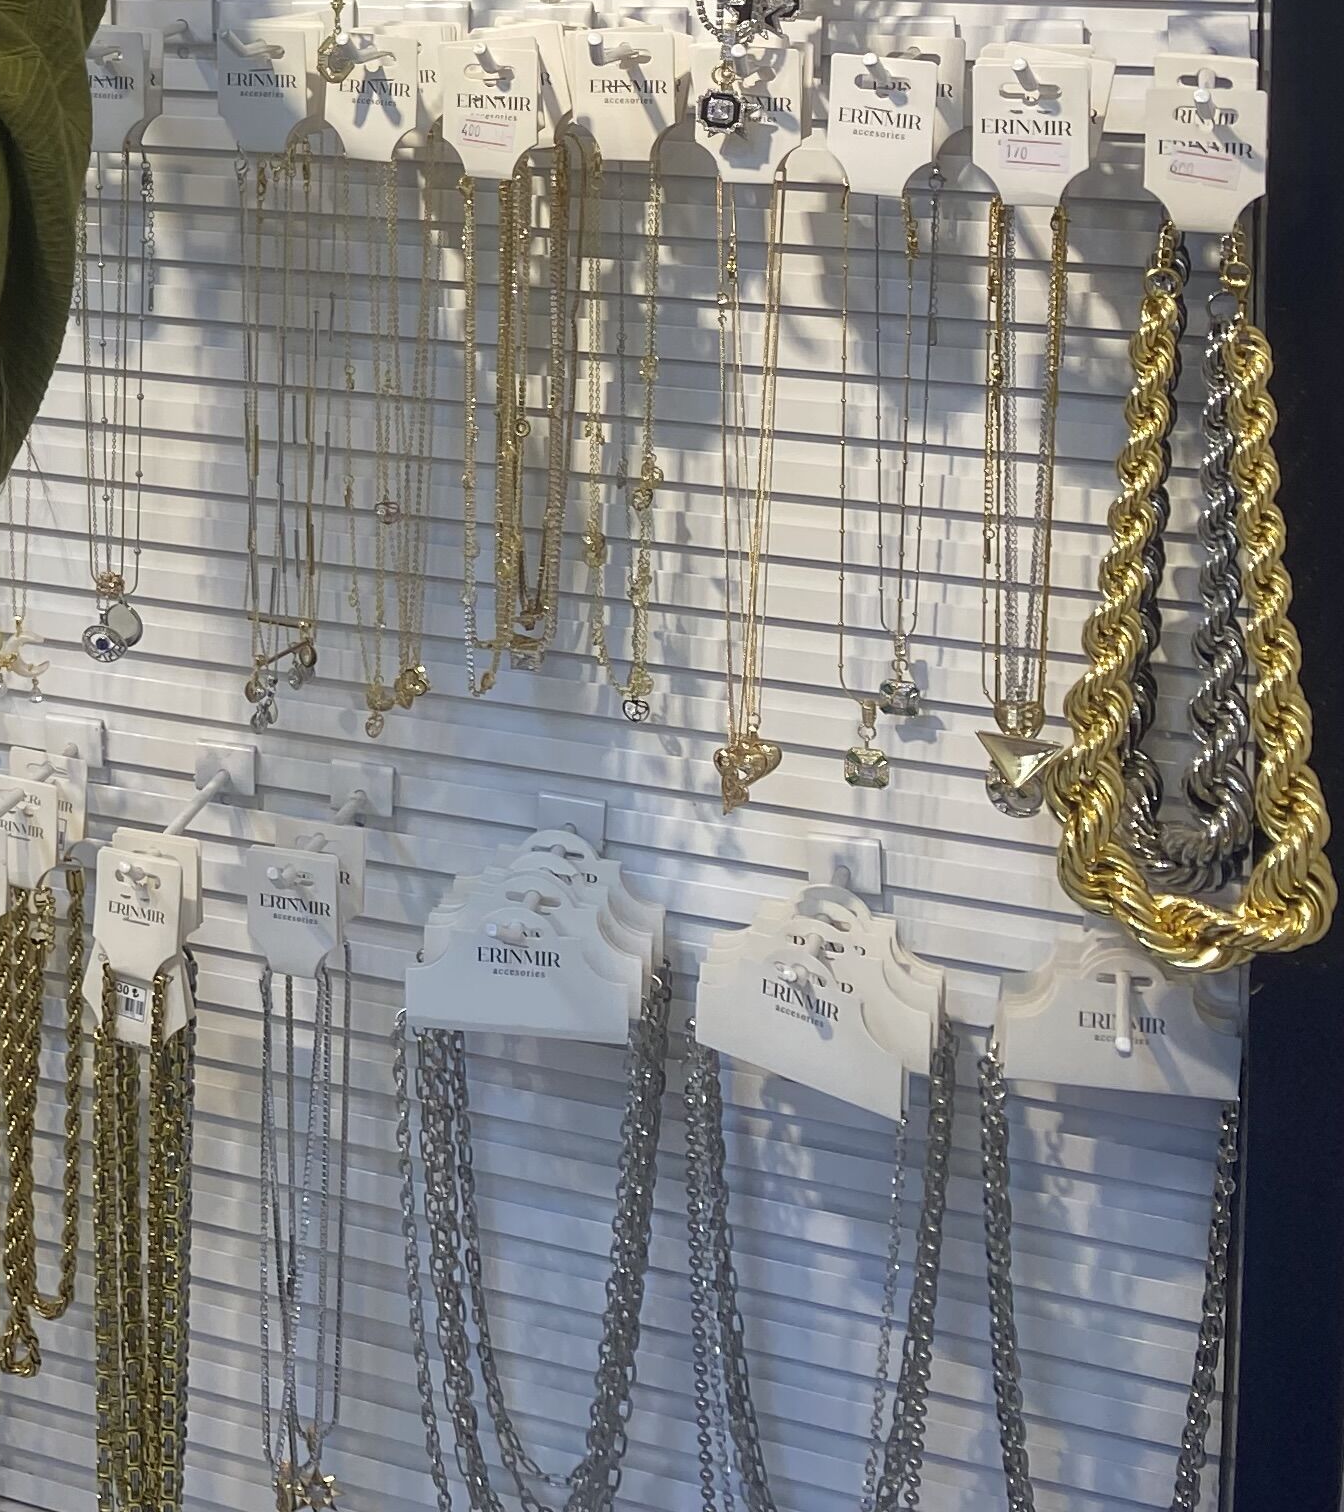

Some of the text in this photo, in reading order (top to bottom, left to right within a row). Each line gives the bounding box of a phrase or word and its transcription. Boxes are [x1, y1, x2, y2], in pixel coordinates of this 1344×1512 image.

[226, 72, 297, 88] ERINMIR
[589, 79, 668, 94] ERINMIR
[456, 93, 532, 112] ERINMIR
[838, 105, 922, 131] ERINMIR
[981, 118, 1073, 136] ERINMIR
[461, 124, 481, 138] 400
[0, 819, 44, 839] RINMIR
[109, 900, 165, 924] ERINMIR
[260, 893, 331, 917] ERINMIR
[477, 947, 561, 968] ERINMIR
[762, 978, 839, 1022] ERINMIR
